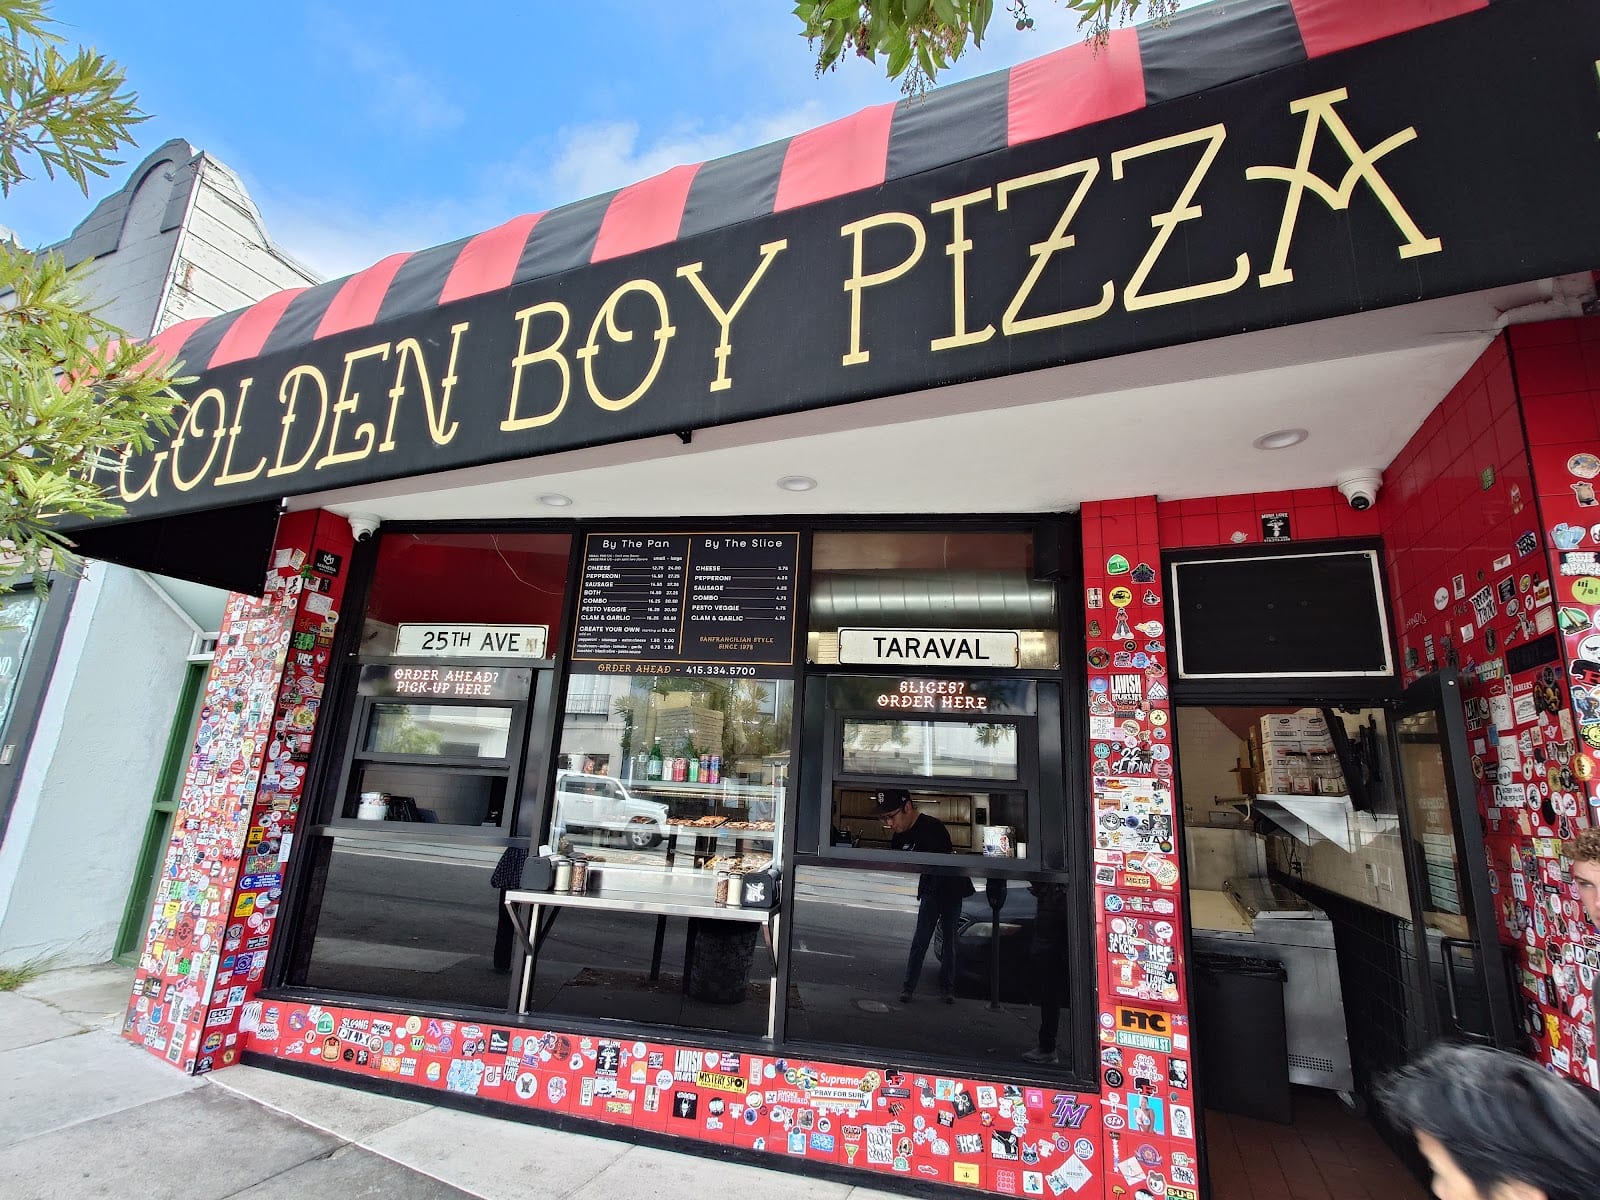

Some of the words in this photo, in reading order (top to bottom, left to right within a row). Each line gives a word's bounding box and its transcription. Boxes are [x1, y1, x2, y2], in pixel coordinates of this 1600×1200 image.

[118, 322, 469, 503] GOLDEN
[499, 238, 788, 434] BOY
[841, 86, 1443, 366] PIZZA
[602, 540, 616, 550] By
[622, 540, 642, 548] The
[648, 540, 670, 548] Pan
[705, 539, 720, 550] By
[725, 538, 746, 548] The
[752, 538, 782, 548] Slice
[422, 632, 471, 650] 25TH
[480, 632, 521, 652] AVE
[873, 637, 990, 660] TARAVAL
[394, 668, 439, 681] ORDER
[444, 670, 499, 683] AHEAD?
[598, 664, 632, 673] ORDER
[636, 664, 672, 674] AHEAD
[686, 665, 756, 676] 415.334.5700
[396, 682, 450, 694] PICK-UP
[455, 683, 492, 696] HERE
[878, 694, 935, 709] ORDER
[941, 696, 988, 710] HERE
[1121, 1010, 1166, 1032] FTC
[1120, 1032, 1160, 1050] SHAKEDOWN
[1160, 1038, 1170, 1052] ST
[699, 1072, 726, 1086] MYSTERY
[727, 1076, 745, 1089] SPOT
[820, 1072, 859, 1086] Supreme
[814, 1089, 832, 1097] PRAY
[848, 1091, 866, 1099] SURF
